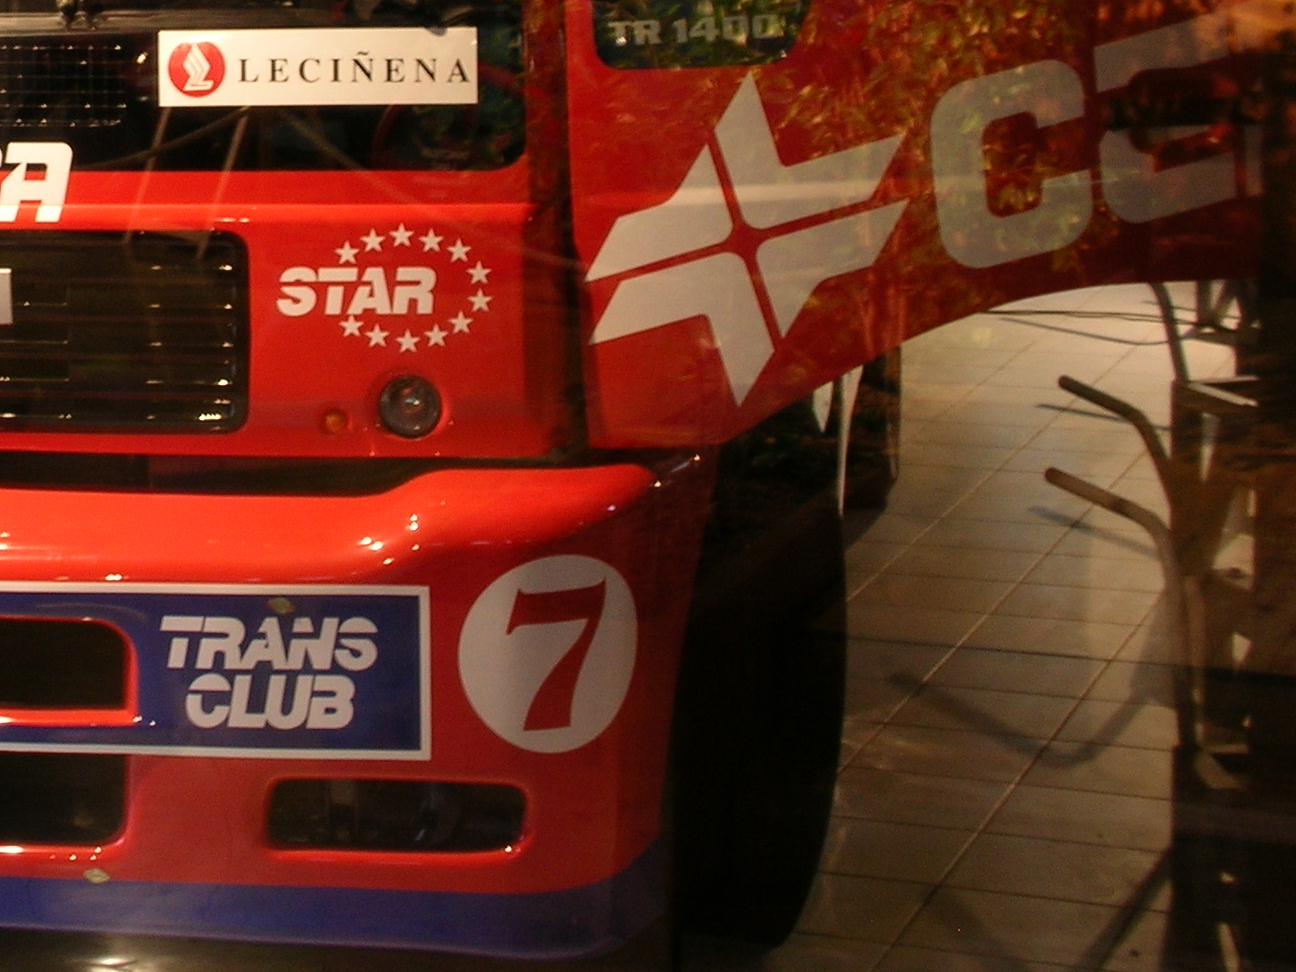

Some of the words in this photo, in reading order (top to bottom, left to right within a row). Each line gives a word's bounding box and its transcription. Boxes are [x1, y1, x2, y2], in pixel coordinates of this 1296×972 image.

[607, 19, 662, 46] TR
[671, 13, 786, 44] 1400
[238, 51, 470, 84] LECIÑENA
[276, 266, 438, 316] STAR
[159, 615, 378, 672] TRANS
[507, 579, 606, 732] 7
[185, 673, 356, 729] CLUB
